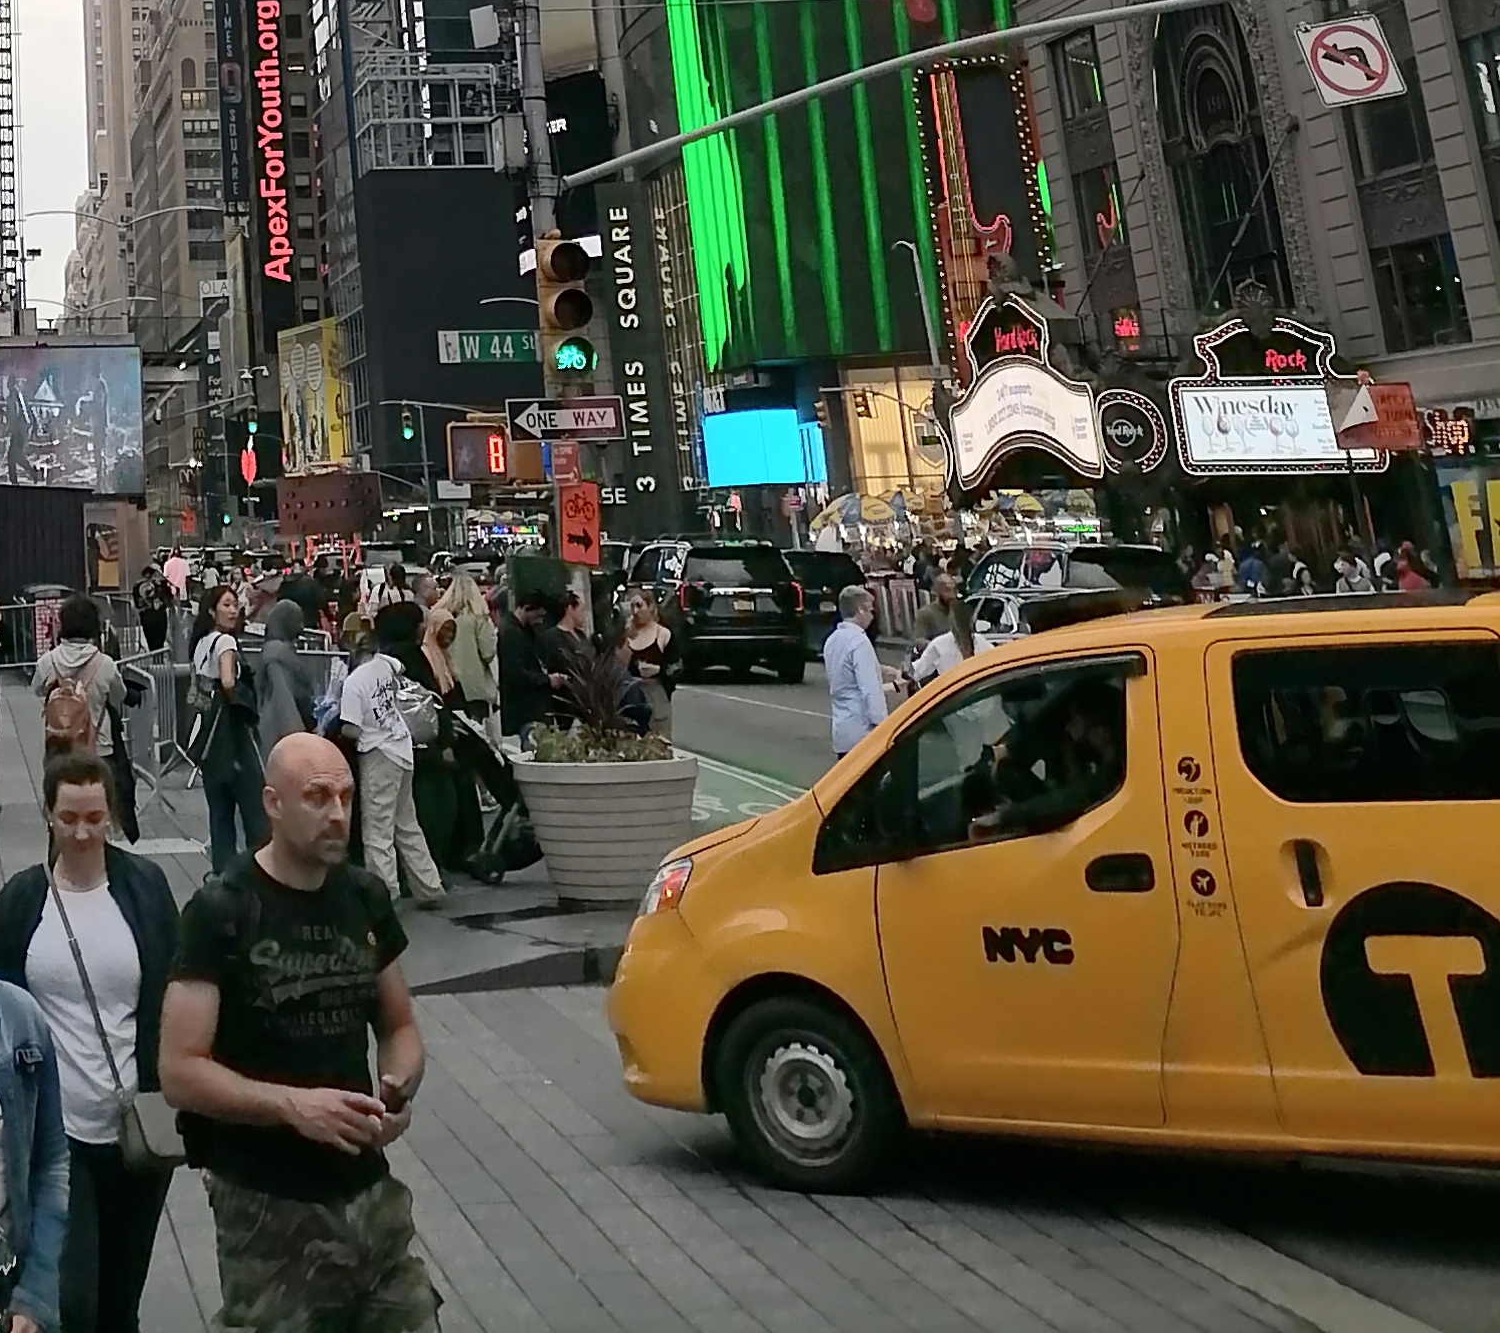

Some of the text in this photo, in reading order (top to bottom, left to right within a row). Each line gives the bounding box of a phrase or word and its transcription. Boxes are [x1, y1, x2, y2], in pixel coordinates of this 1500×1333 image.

[228, 108, 241, 196] SQUARE
[255, 0, 295, 282] ApexForYouth.org
[462, 335, 479, 359] W
[490, 334, 514, 359] 44
[609, 206, 657, 493] 3 TIMES SQUARE
[1265, 348, 1307, 372] Rock
[526, 410, 608, 428] ONE WAY
[1191, 394, 1299, 418] Winesday
[981, 925, 1075, 965] NYC
